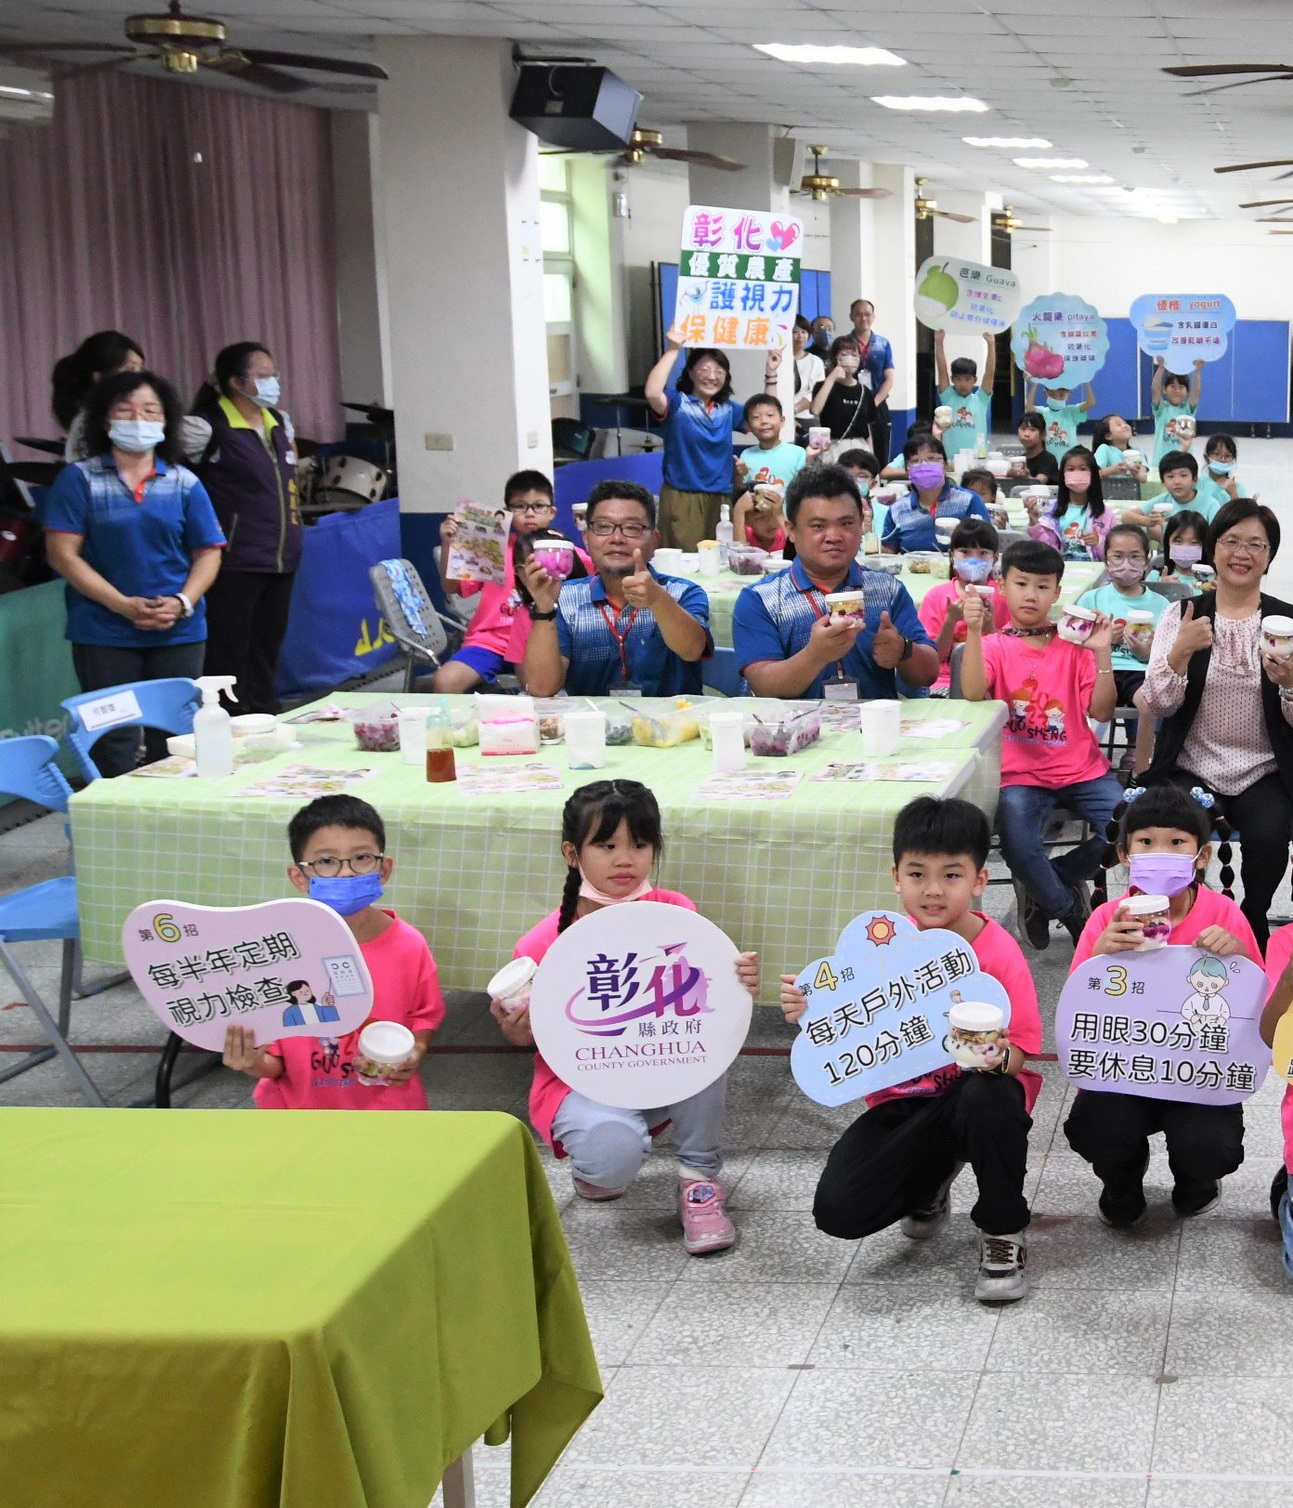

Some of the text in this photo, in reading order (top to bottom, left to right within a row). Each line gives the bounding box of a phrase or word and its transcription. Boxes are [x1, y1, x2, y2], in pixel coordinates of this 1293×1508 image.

[692, 212, 762, 250] 彰化
[689, 252, 793, 281] 優質農產
[960, 268, 1016, 287] 芭樂 Guava
[710, 281, 793, 312] 護視力
[1189, 300, 1220, 309] yogurt
[680, 314, 770, 346] 保健康
[1033, 312, 1094, 322] 火龍果 pitaya
[138, 913, 199, 943] 第6招
[148, 931, 298, 989] 每半年定期
[586, 952, 700, 1018] 彰化
[799, 961, 855, 997] 第4招
[1088, 965, 1145, 996] 第3招
[166, 976, 290, 1025] 視力檢查
[805, 948, 972, 1045] 每天戶外活動
[639, 1019, 702, 1038] 縣政府
[1071, 1013, 1228, 1051] 用眼30分鐘
[575, 1040, 706, 1061] CHANGHUA
[577, 1055, 706, 1072] COUNTY GOVERNMENT
[823, 1015, 932, 1084] 120分鐘
[1068, 1049, 1255, 1091] 要休息10分鐘
